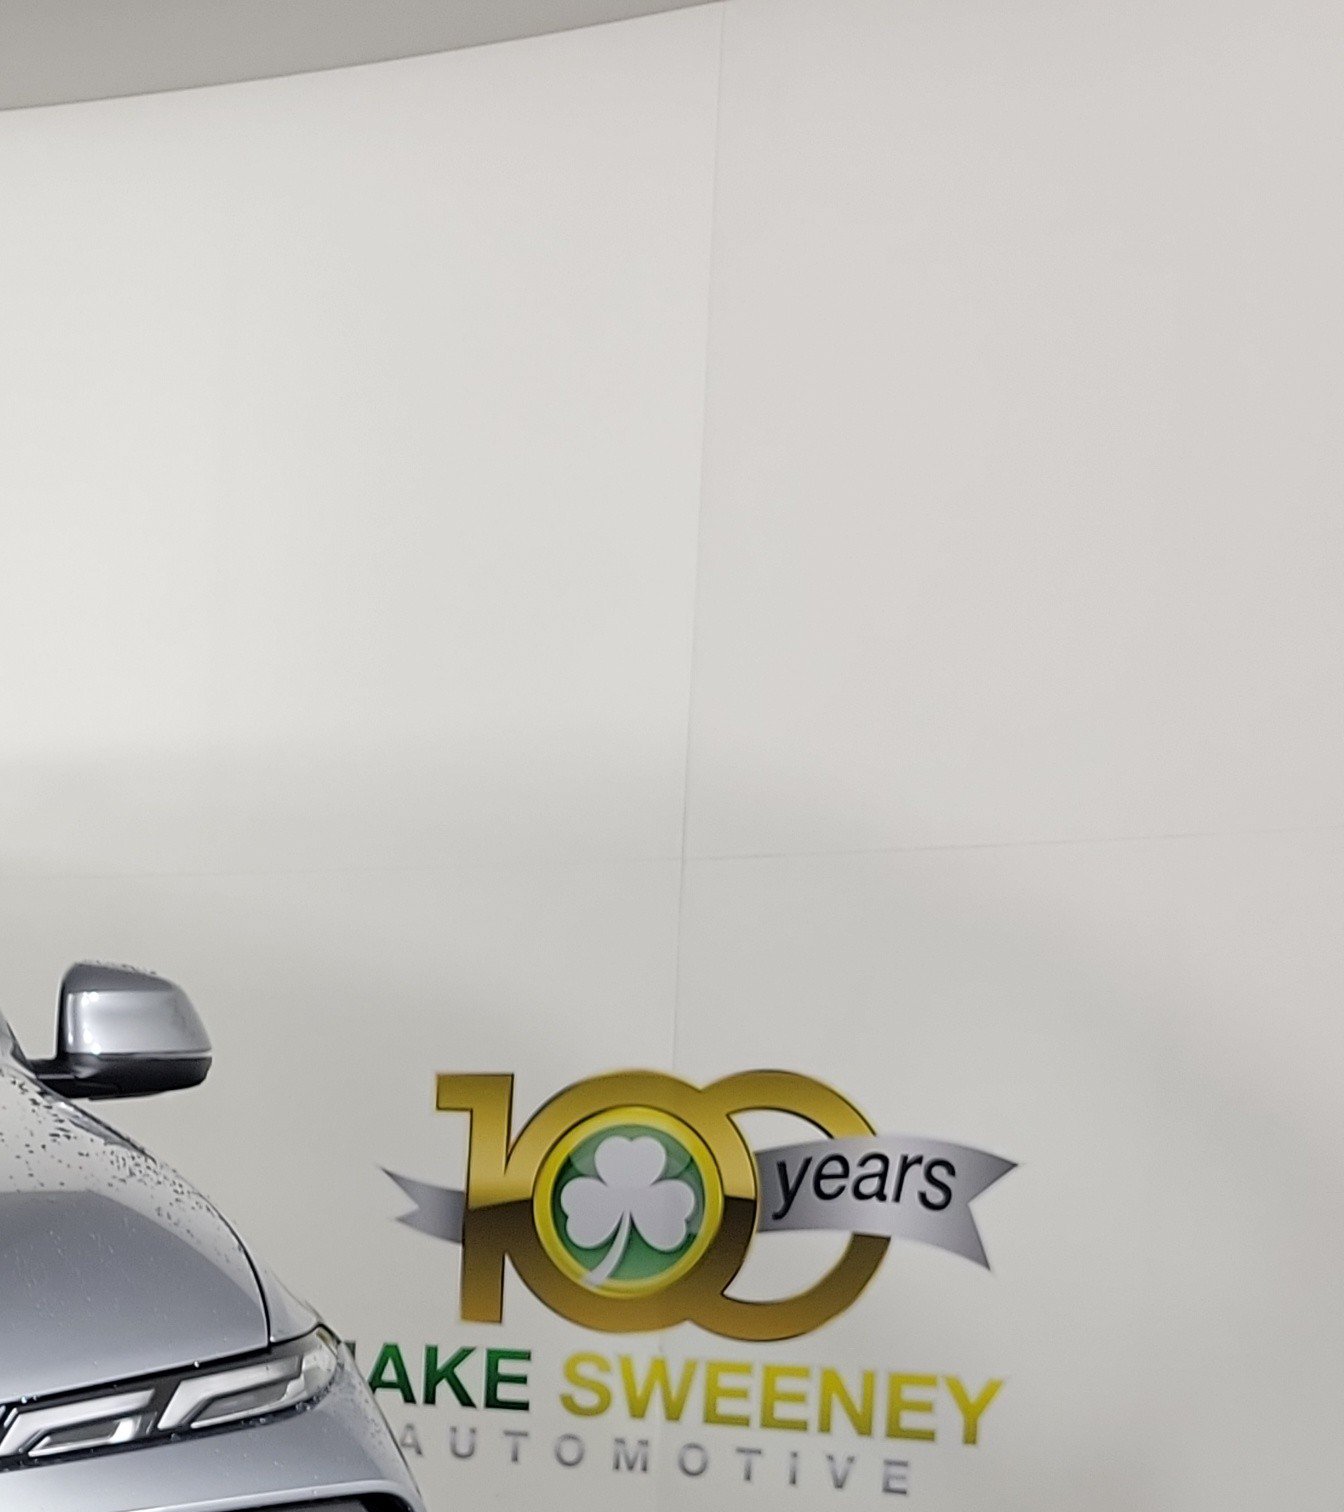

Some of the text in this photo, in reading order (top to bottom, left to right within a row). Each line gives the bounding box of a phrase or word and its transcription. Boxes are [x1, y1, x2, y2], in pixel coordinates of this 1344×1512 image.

[436, 1069, 958, 1342] 100 years
[344, 1340, 1005, 1446] AKE SWEENEY
[399, 1422, 910, 1496] AUTOMOTIVE
